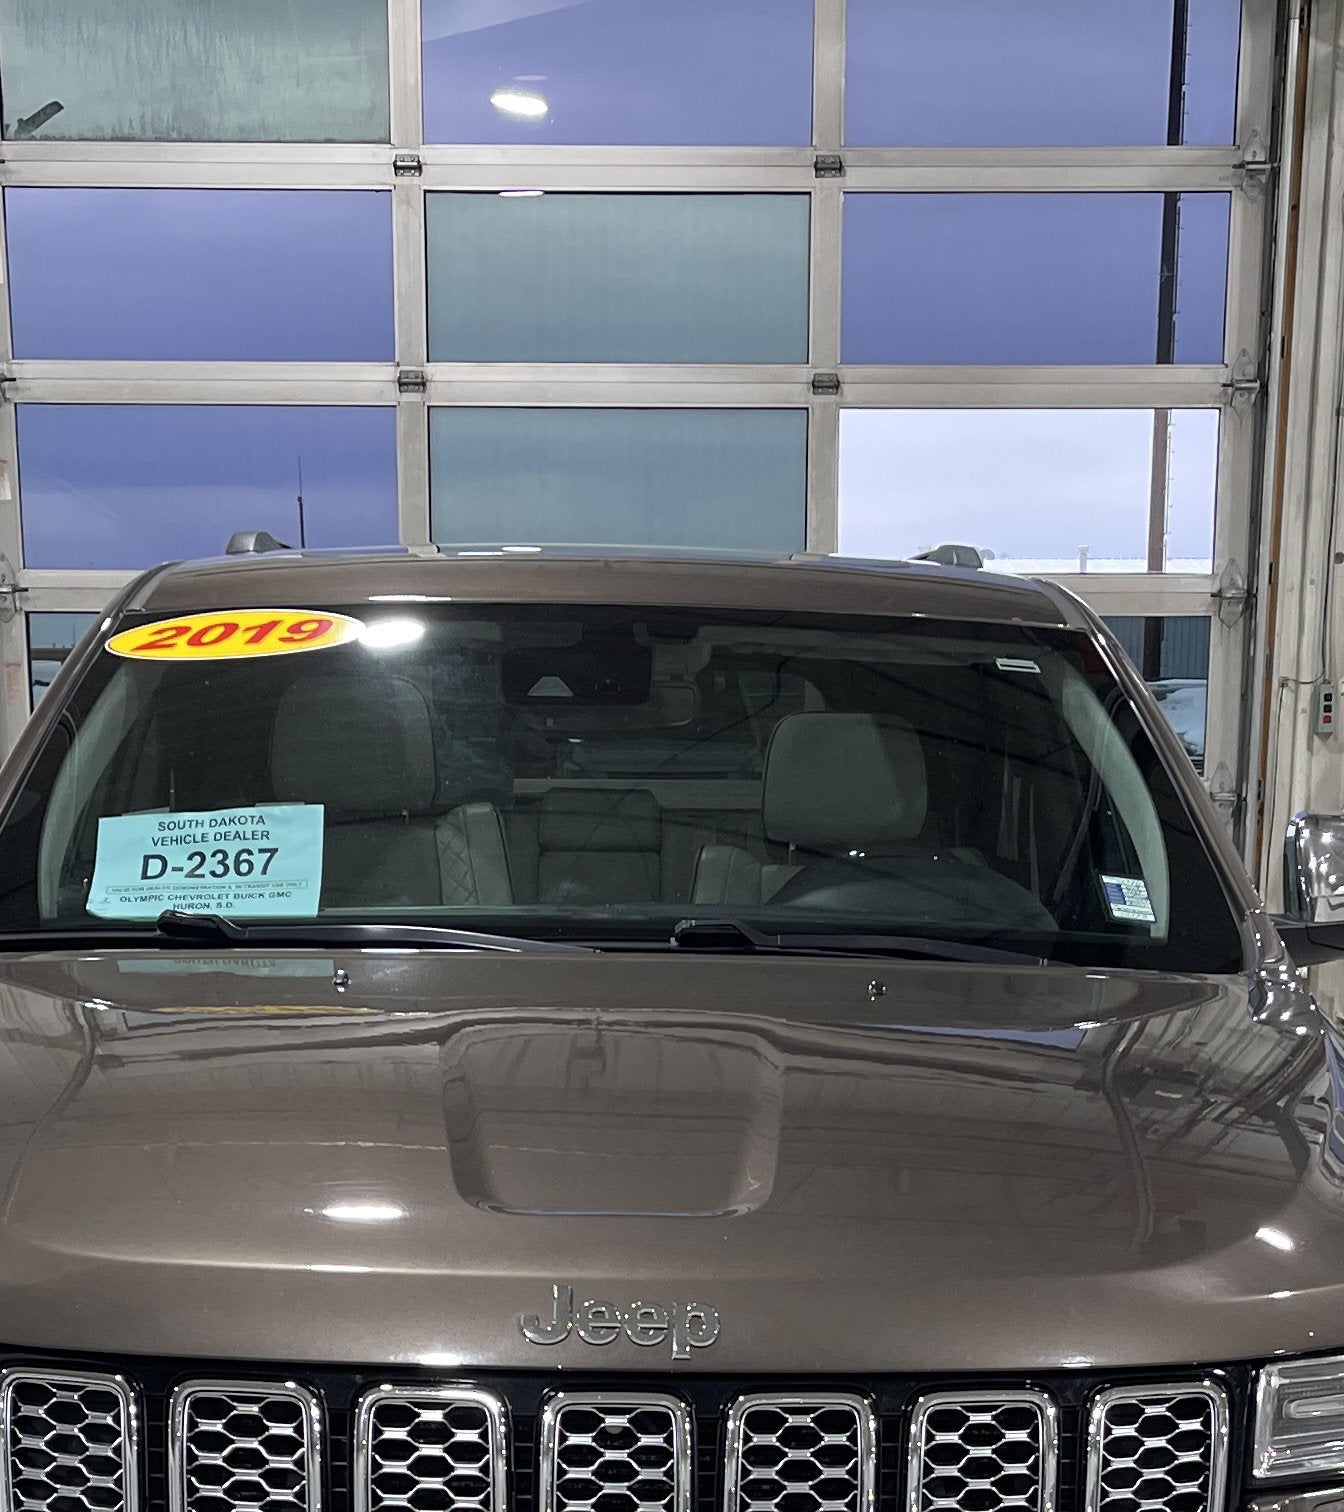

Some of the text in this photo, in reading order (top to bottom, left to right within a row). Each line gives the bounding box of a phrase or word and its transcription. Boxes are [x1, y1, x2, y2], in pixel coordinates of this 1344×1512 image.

[133, 617, 335, 652] 2019
[157, 815, 266, 832] SOUTH DAKOTA
[151, 830, 271, 848] VEHICLE DEALER
[140, 847, 280, 881] D-2367
[119, 894, 164, 903] OLYMPIC
[167, 893, 230, 901] CHEVROLET
[233, 891, 265, 900] BUICK
[268, 890, 292, 898] GMC
[520, 1284, 720, 1360] Jeep
